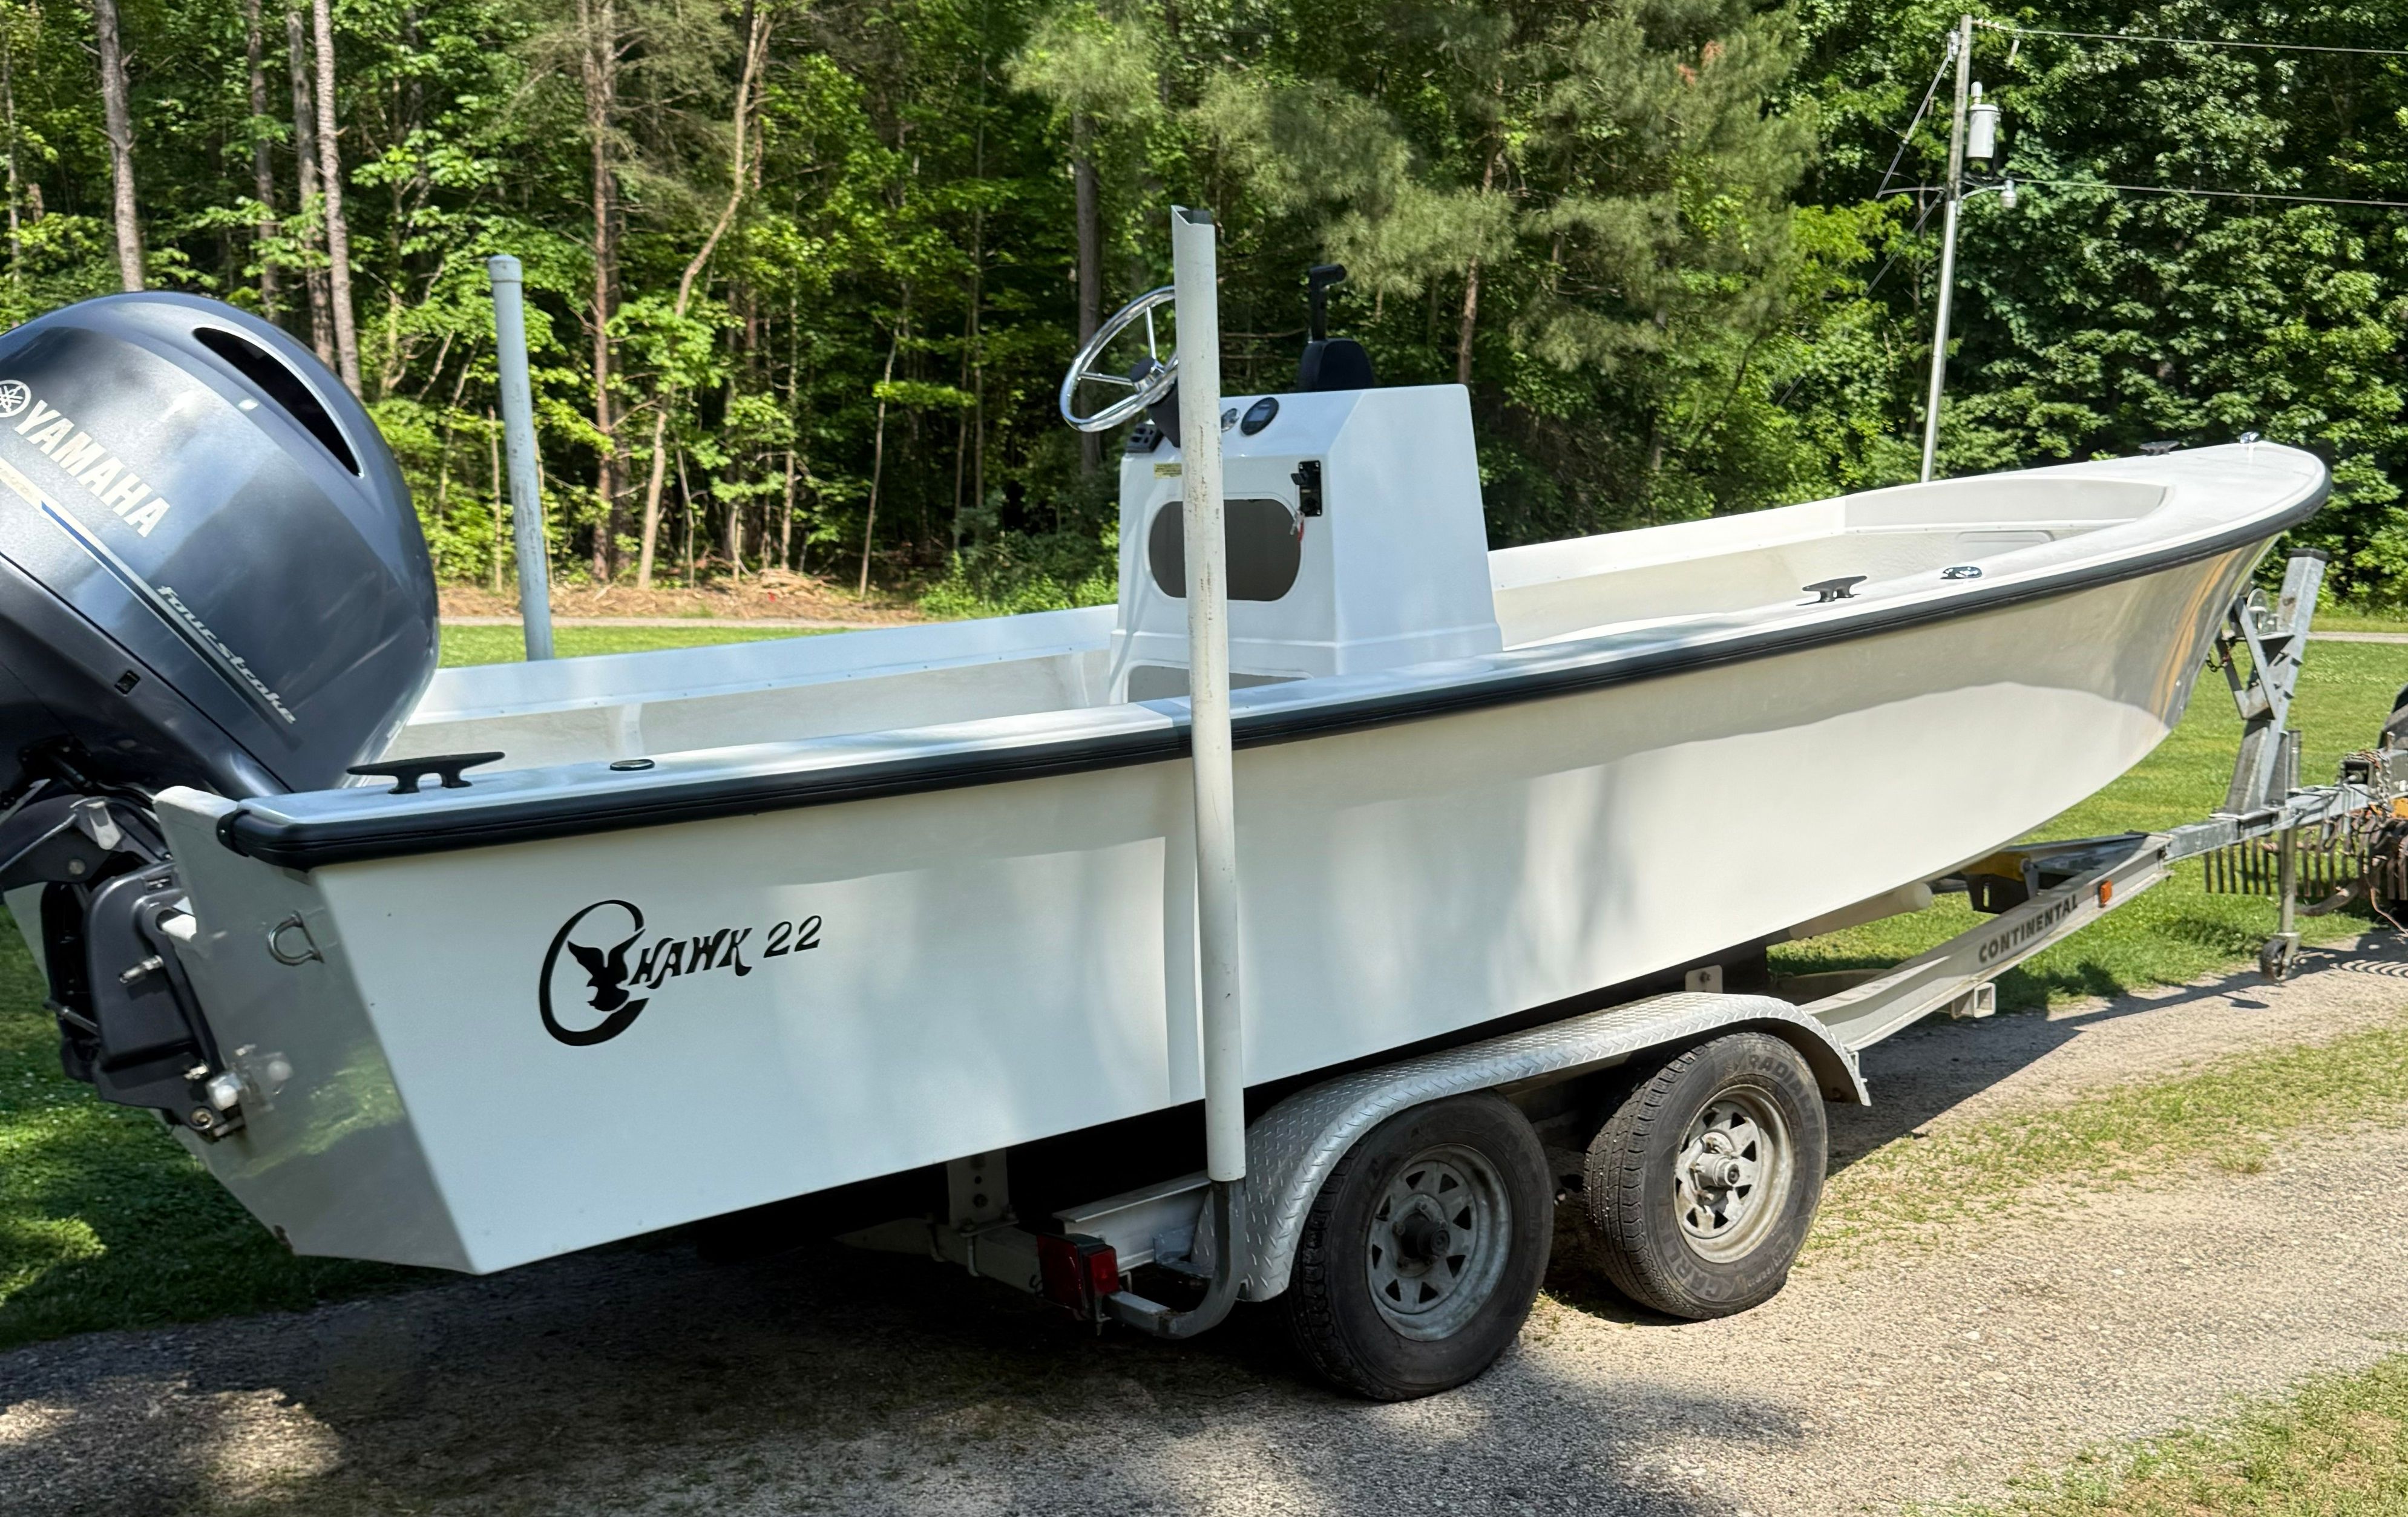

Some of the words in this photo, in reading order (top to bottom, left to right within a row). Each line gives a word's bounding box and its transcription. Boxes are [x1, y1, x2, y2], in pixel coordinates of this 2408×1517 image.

[15, 399, 170, 537] YAMAHA
[629, 927, 753, 989] HAWK
[763, 915, 822, 958] 22
[1978, 893, 2079, 963] CONTINENTAL
